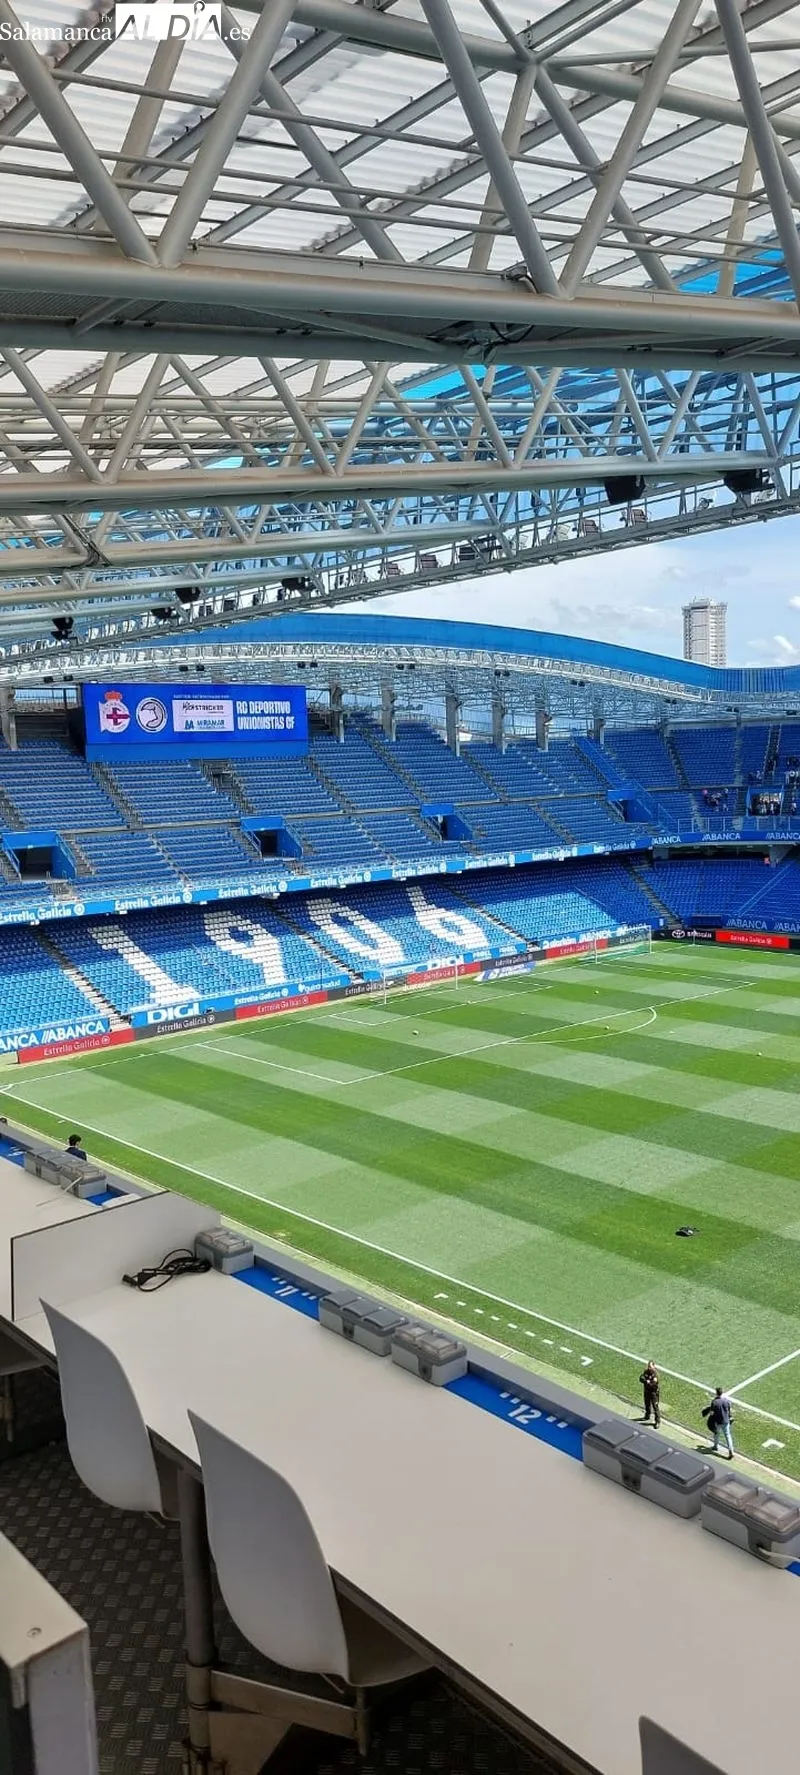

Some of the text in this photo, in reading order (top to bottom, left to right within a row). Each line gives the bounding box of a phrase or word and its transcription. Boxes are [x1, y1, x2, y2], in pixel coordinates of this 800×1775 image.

[236, 701, 291, 714] RC DEPORTIVO
[237, 716, 285, 730] UNIONISTAS
[114, 893, 181, 911] Estrella Galicia
[37, 906, 72, 920] Galicia
[147, 1002, 200, 1024] DIGI
[45, 1020, 106, 1043] ABANCA
[157, 1017, 207, 1033] Estrella Galicia
[43, 1038, 100, 1056] Estrella Galicia
[507, 1404, 543, 1424] 12
